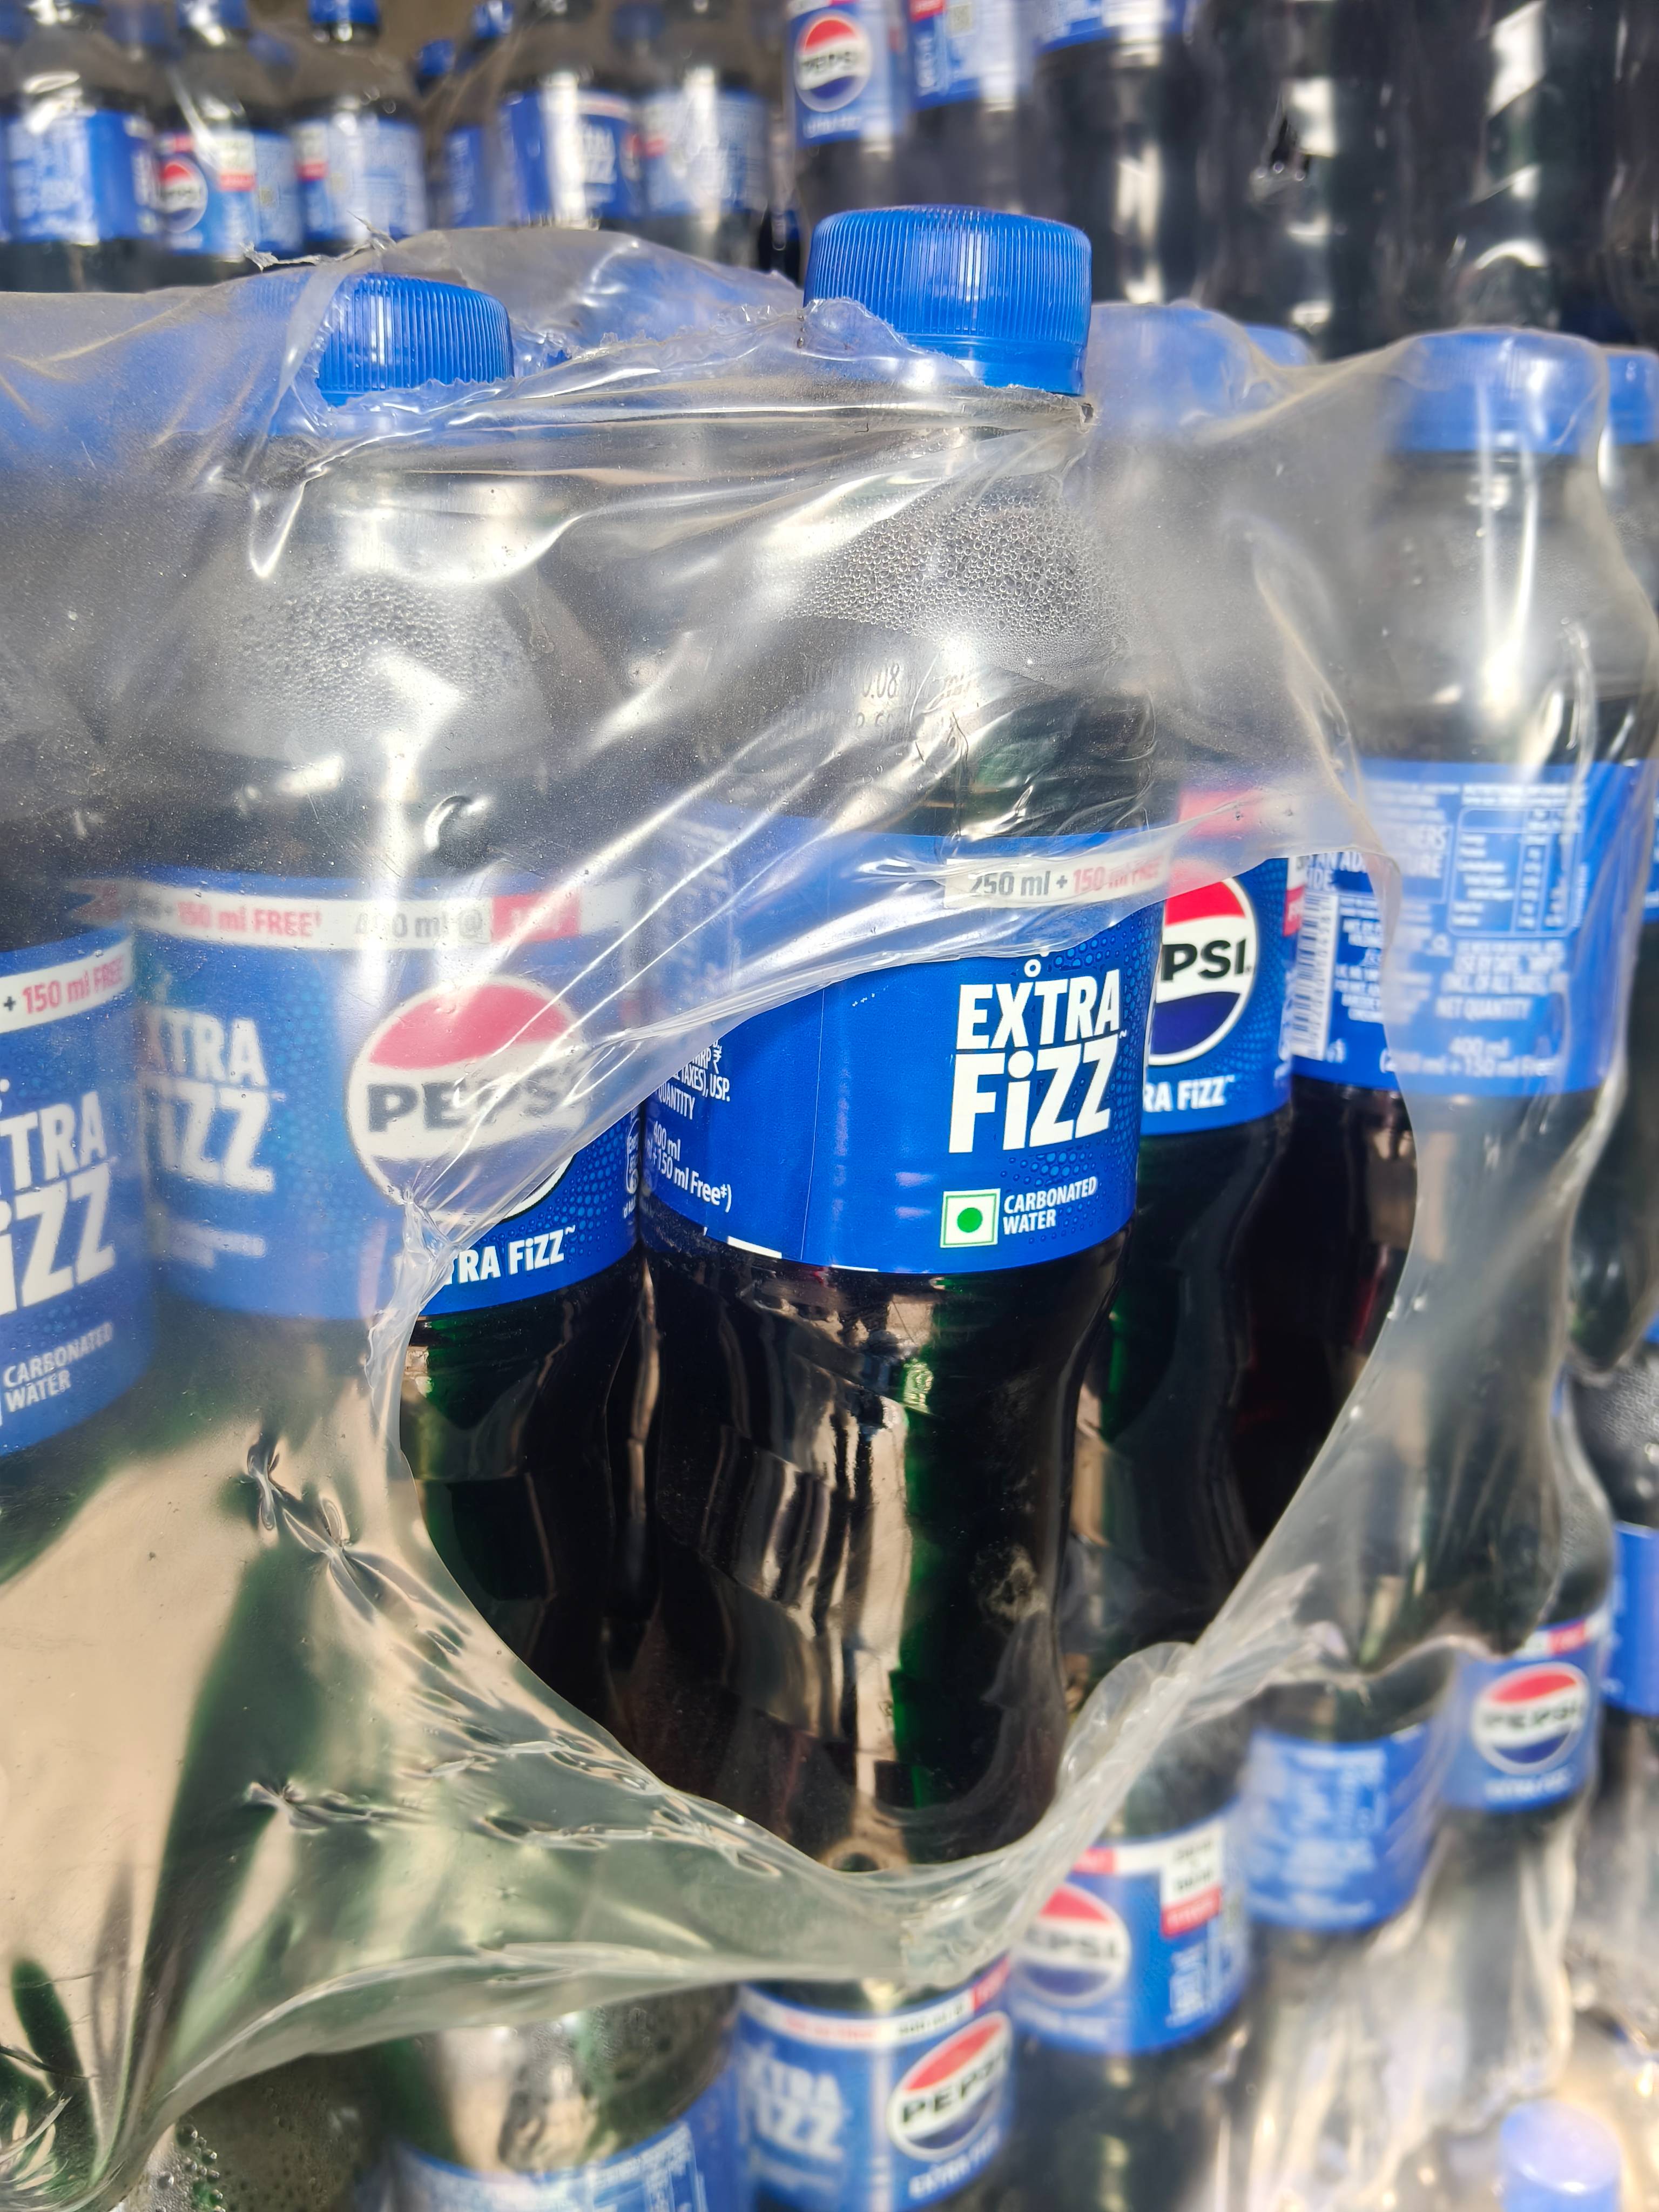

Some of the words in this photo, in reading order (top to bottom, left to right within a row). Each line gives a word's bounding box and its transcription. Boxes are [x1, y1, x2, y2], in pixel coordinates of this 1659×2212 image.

[1020, 871, 1051, 896] ml
[1073, 866, 1105, 893] 150
[23, 981, 60, 1014] 150
[66, 974, 90, 1002] ml
[956, 969, 1120, 1049] EXTRA
[658, 1081, 696, 1120] QUANTITY
[710, 1073, 731, 1102] USP.
[0, 1091, 107, 1191] TRA
[667, 1137, 680, 1162] ml
[657, 1147, 673, 1181] 150
[673, 1164, 689, 1191] ml
[1003, 1176, 1098, 1215] CARBONATED
[1003, 1209, 1056, 1236] WATER
[3, 1321, 113, 1388] CARBONATED
[4, 1370, 71, 1412] WATER
